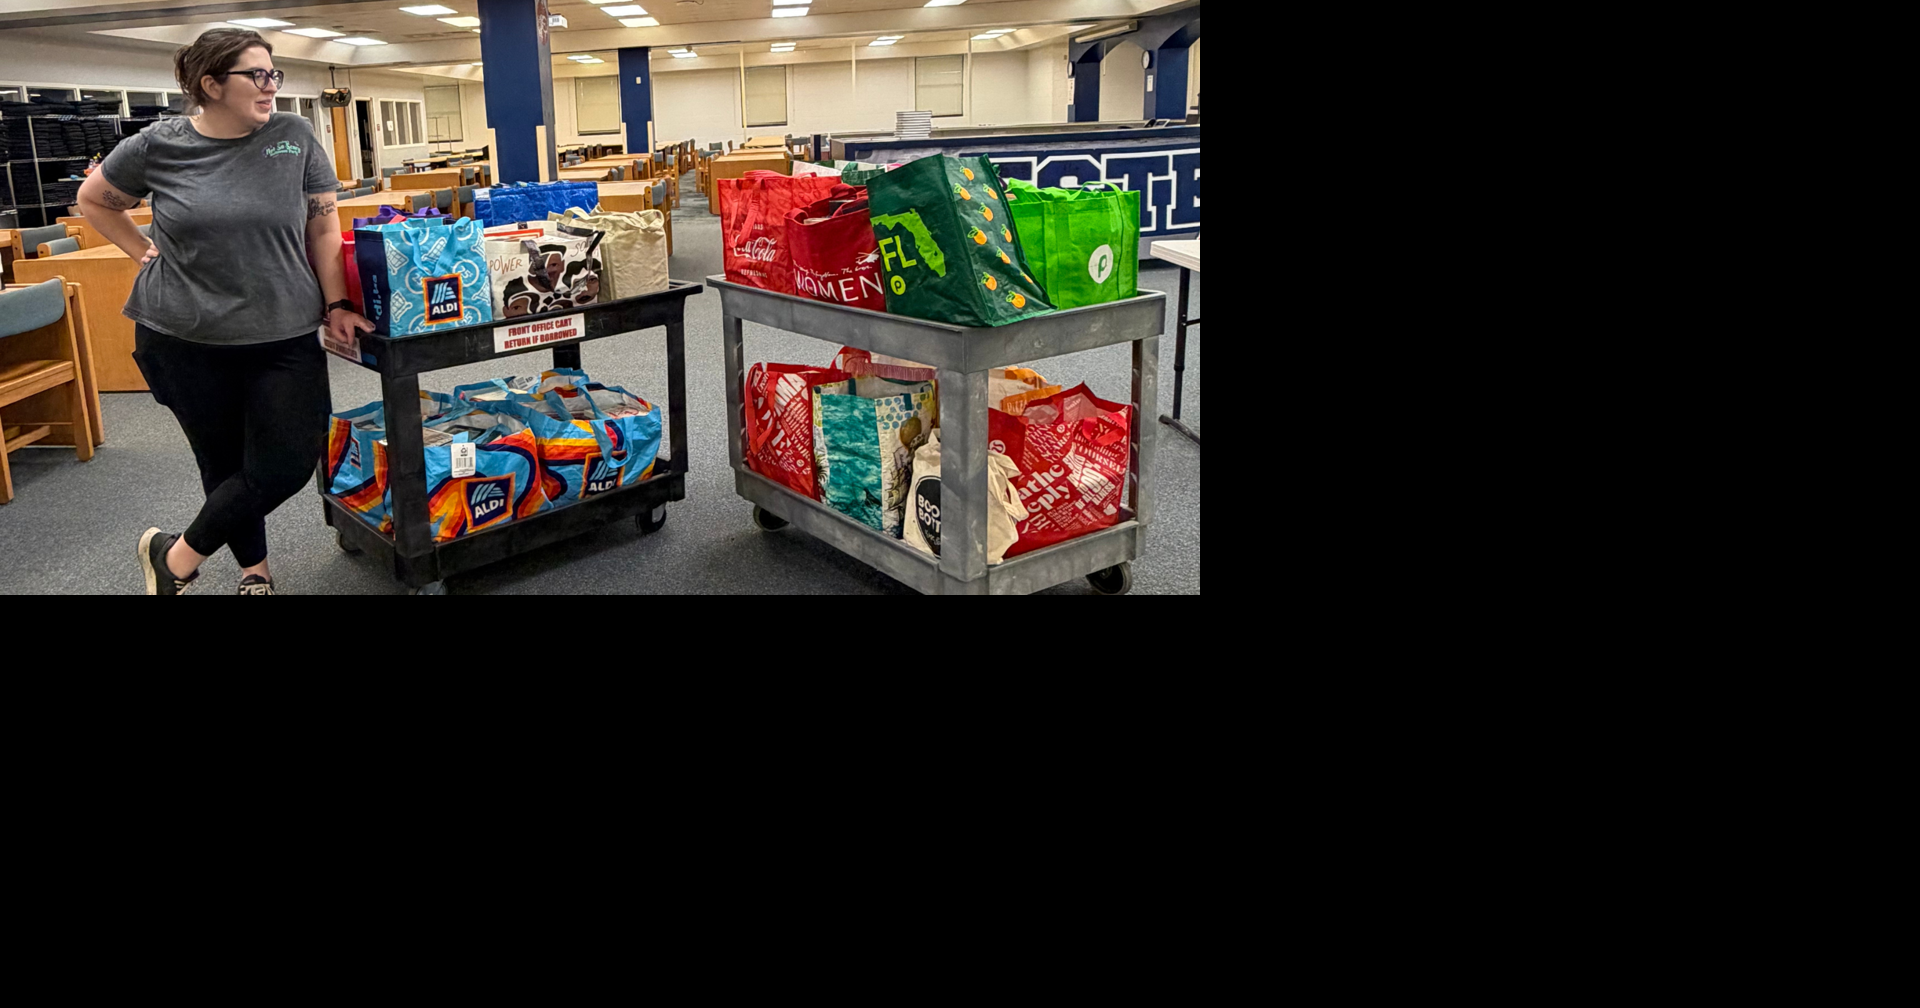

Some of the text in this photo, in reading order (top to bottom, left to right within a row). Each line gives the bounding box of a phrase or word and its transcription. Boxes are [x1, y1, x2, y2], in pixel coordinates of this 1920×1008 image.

[878, 235, 917, 272] FL
[489, 256, 522, 275] POWER
[793, 268, 884, 302] WOMEN
[432, 302, 458, 316] ALDI
[508, 318, 572, 337] FRONT OFFICE CART
[504, 337, 531, 349] RETURN
[532, 335, 539, 344] IF
[540, 328, 577, 343] BORROWED
[588, 480, 616, 491] ALDI
[1089, 482, 1115, 505] ILLNESS
[475, 498, 504, 518] ALDI
[1075, 499, 1085, 509] OF
[1082, 490, 1095, 502] ALL
